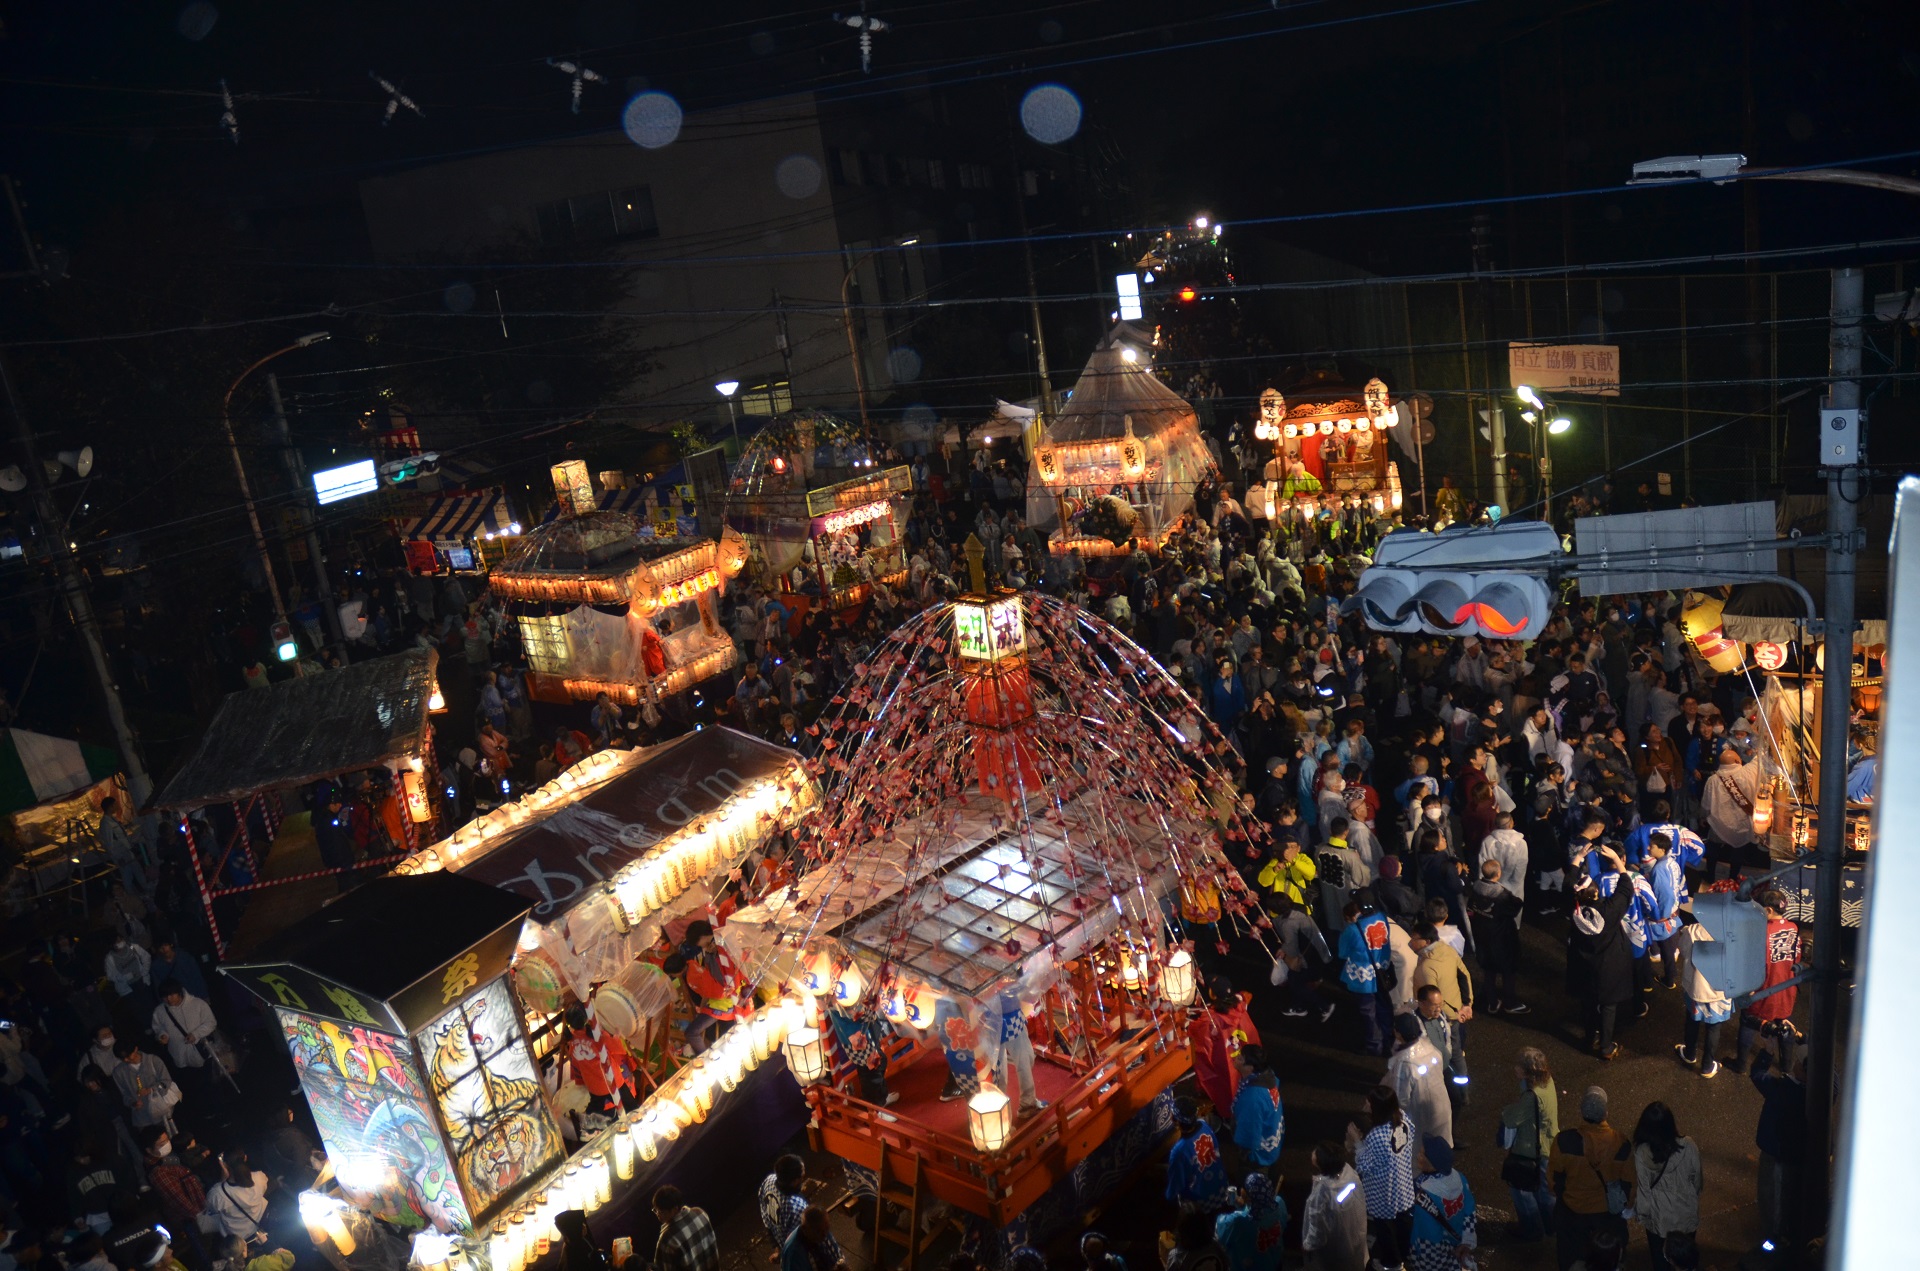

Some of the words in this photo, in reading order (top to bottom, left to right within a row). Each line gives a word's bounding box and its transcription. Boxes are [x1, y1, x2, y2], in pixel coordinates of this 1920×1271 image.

[1513, 349, 1541, 368] 自立
[1546, 349, 1577, 370] 協働
[1581, 350, 1614, 372] 貢献
[496, 767, 746, 914] Dream
[440, 952, 480, 1005] 祭
[113, 1227, 152, 1248] HONDA
